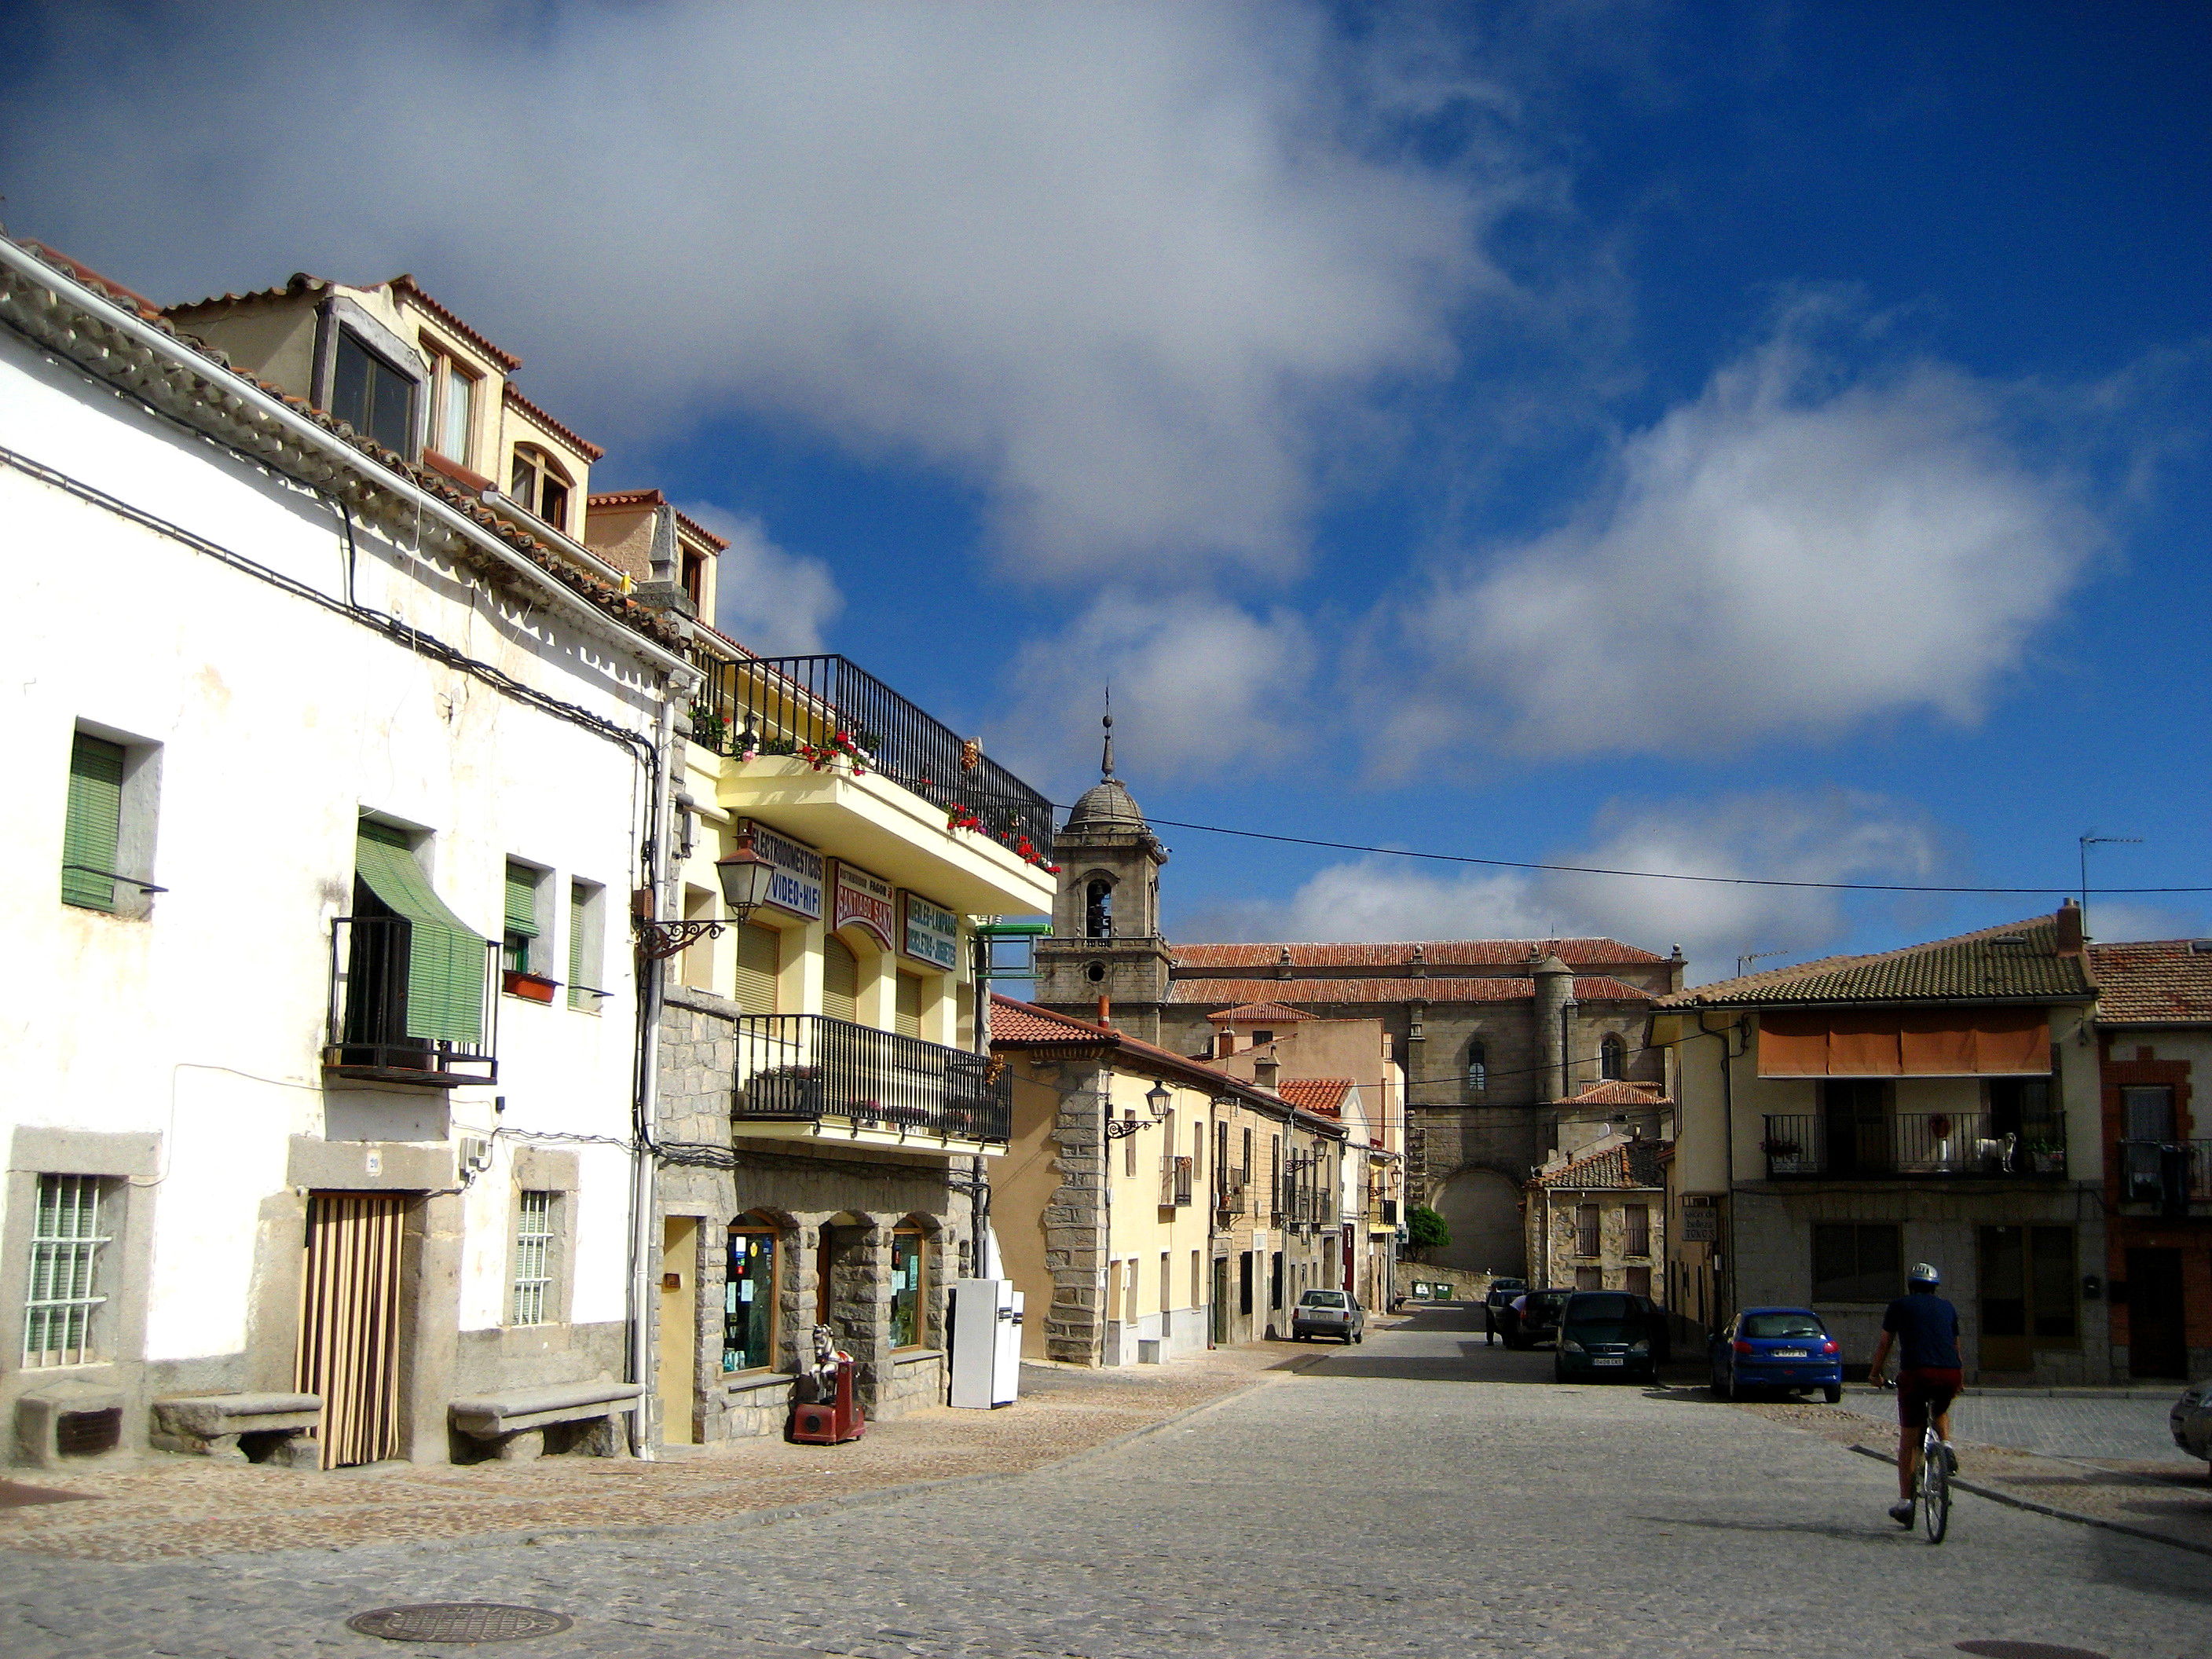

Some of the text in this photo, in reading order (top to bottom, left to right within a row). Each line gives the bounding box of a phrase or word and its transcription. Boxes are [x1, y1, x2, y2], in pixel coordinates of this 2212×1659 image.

[772, 872, 821, 914] VIDEO-HIFI
[838, 886, 892, 940] SANTIAGO SANZ
